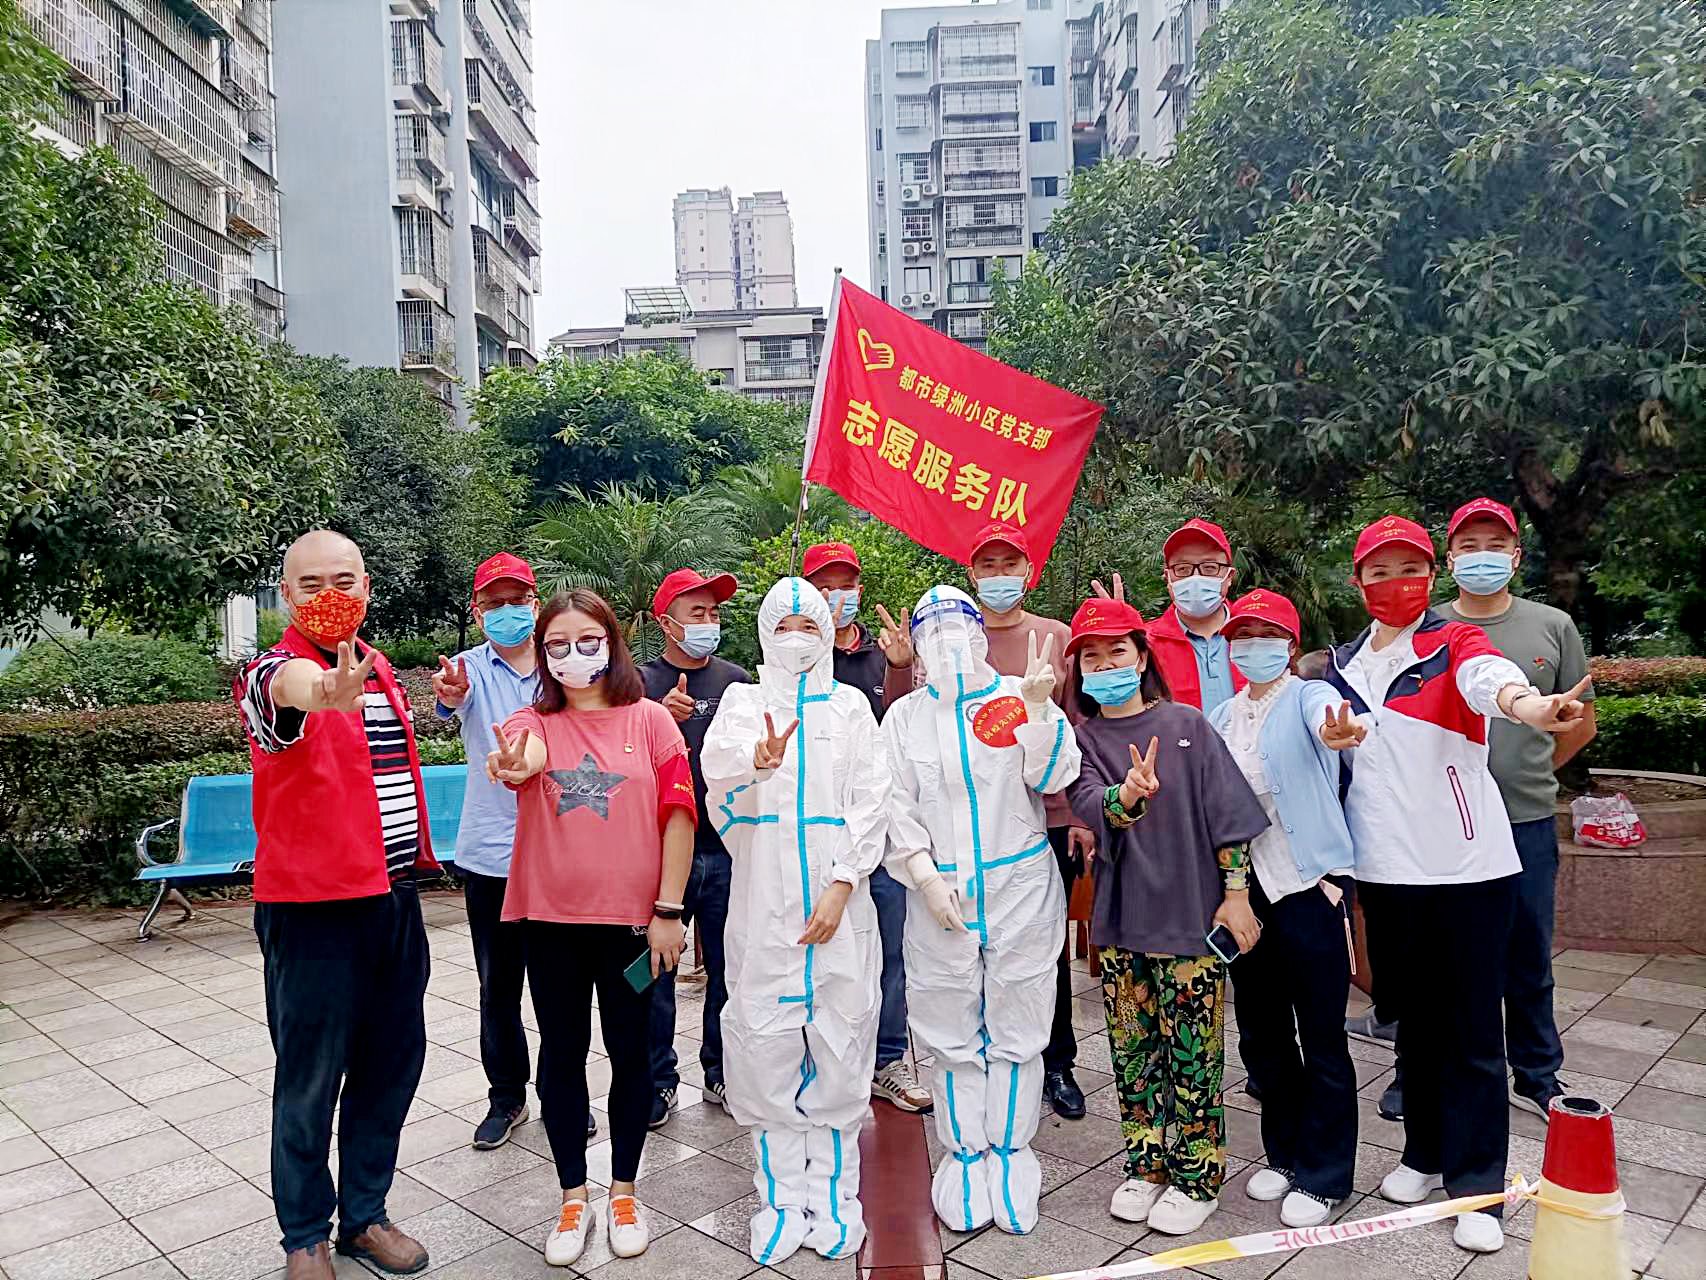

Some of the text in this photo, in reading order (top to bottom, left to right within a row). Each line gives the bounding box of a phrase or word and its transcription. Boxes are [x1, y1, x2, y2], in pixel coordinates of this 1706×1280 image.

[899, 365, 1053, 451] 都市绿洲小区党支部
[841, 399, 1029, 527] 志愿服务队
